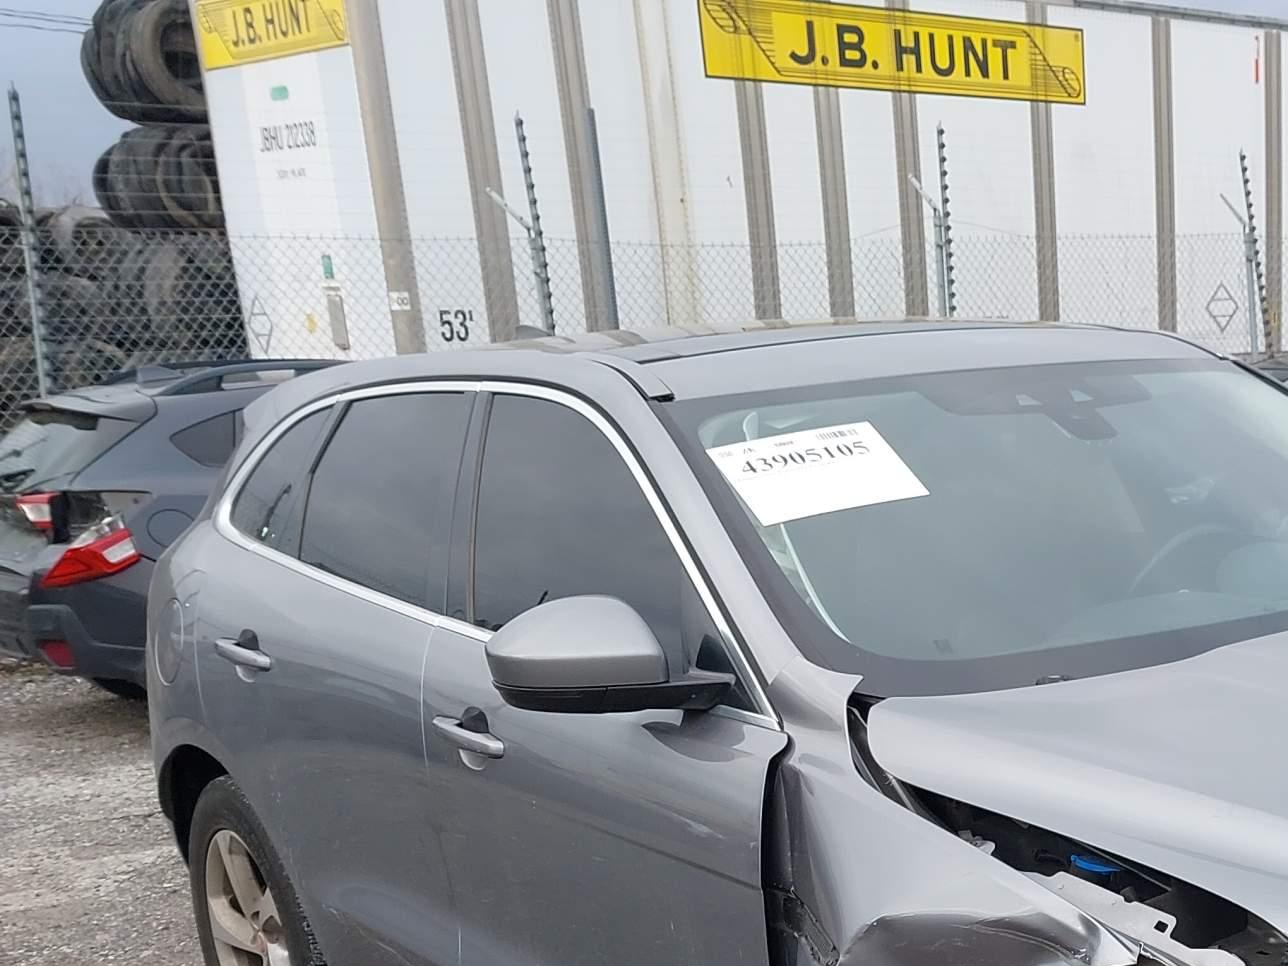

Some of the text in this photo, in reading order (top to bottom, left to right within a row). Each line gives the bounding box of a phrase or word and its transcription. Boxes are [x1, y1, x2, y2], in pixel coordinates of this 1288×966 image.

[232, 0, 312, 47] J.B. HUNT
[789, 20, 1017, 81] J.B. HUNT
[742, 440, 871, 474] 43905105
